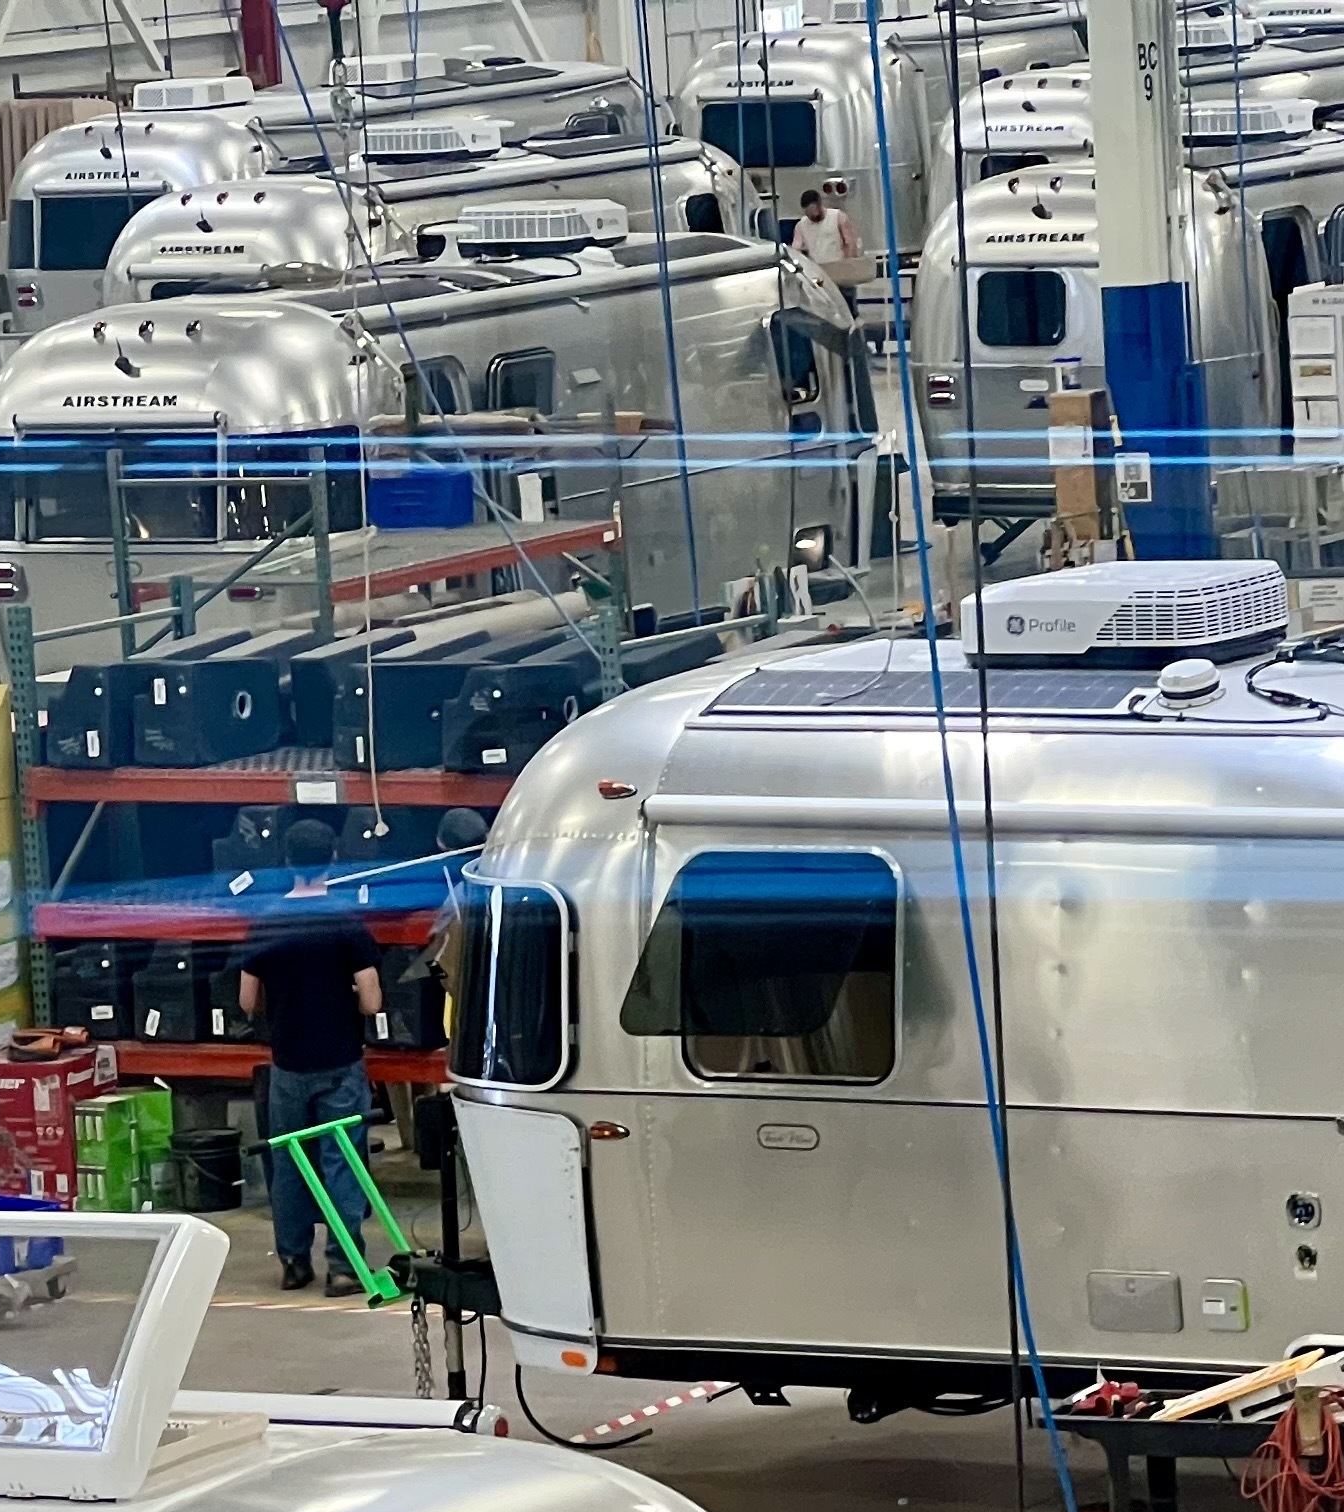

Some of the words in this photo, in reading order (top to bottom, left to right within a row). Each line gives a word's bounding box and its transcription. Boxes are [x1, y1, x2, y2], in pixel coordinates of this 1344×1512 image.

[1137, 42, 1158, 70] BC
[1144, 73, 1154, 101] 9
[65, 171, 140, 180] AIRSTREAM
[985, 233, 1086, 243] AIRSTREAM
[158, 246, 245, 255] AIRSTREAM
[62, 395, 178, 407] AIRSTREAM
[1029, 618, 1076, 632] Profile
